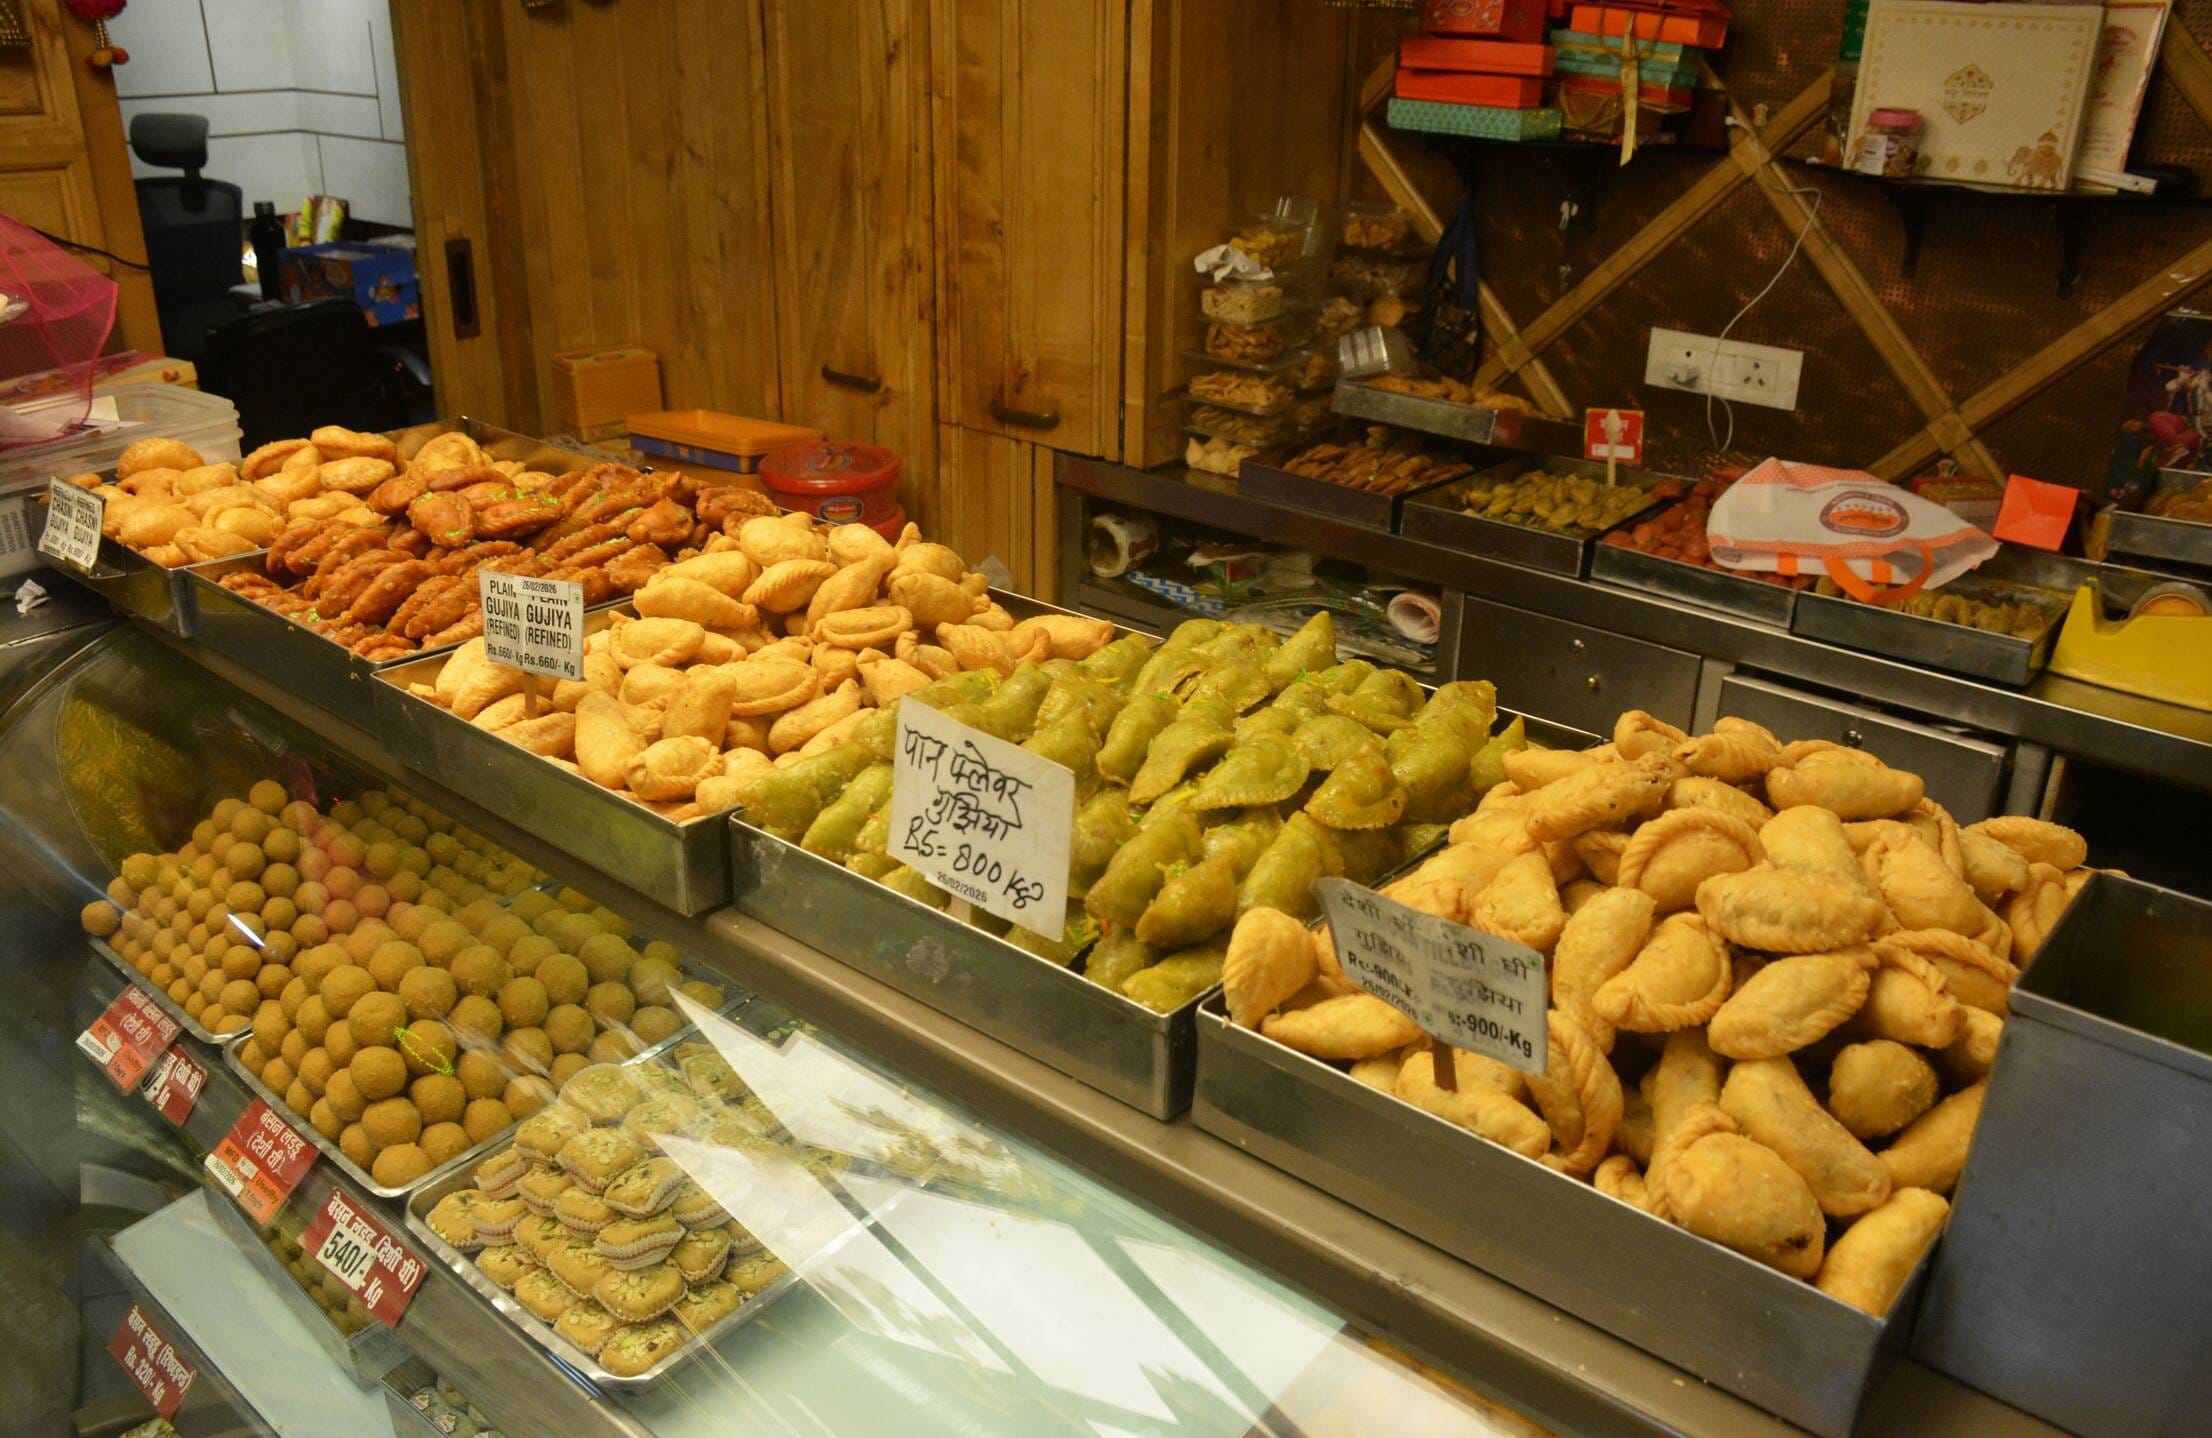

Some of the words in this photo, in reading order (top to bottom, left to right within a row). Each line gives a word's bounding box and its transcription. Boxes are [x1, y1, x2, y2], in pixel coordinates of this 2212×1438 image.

[50, 514, 69, 535] GUJIYA
[76, 509, 98, 532] CHASNI
[74, 526, 92, 548] GUJIYA
[522, 581, 557, 594] 26/02/2026
[486, 597, 520, 621] GUJIYA
[526, 604, 572, 630] GUJIYA
[486, 618, 520, 644] (REFINED)
[525, 627, 572, 651] (REFINED)
[564, 661, 575, 676] Kg
[904, 724, 948, 783] पान
[926, 785, 1022, 842] गुझिया
[953, 844, 1002, 884] 800
[936, 870, 988, 903] 26/02/2026
[1501, 956, 1527, 981] घी
[187, 1070, 203, 1098] घी)
[156, 1085, 171, 1111] Kg
[260, 1108, 286, 1137] बेसन
[280, 1128, 306, 1161] लड्डू
[246, 1130, 274, 1159] (देशी
[266, 1150, 286, 1173] घी)
[328, 1191, 355, 1224] बेसन
[374, 1234, 403, 1273] (देशी
[398, 1258, 420, 1292] घी)
[324, 1230, 368, 1278] 540/-
[364, 1277, 384, 1310] Kg
[128, 1305, 147, 1336] बेसन
[152, 1378, 166, 1406] Kg
